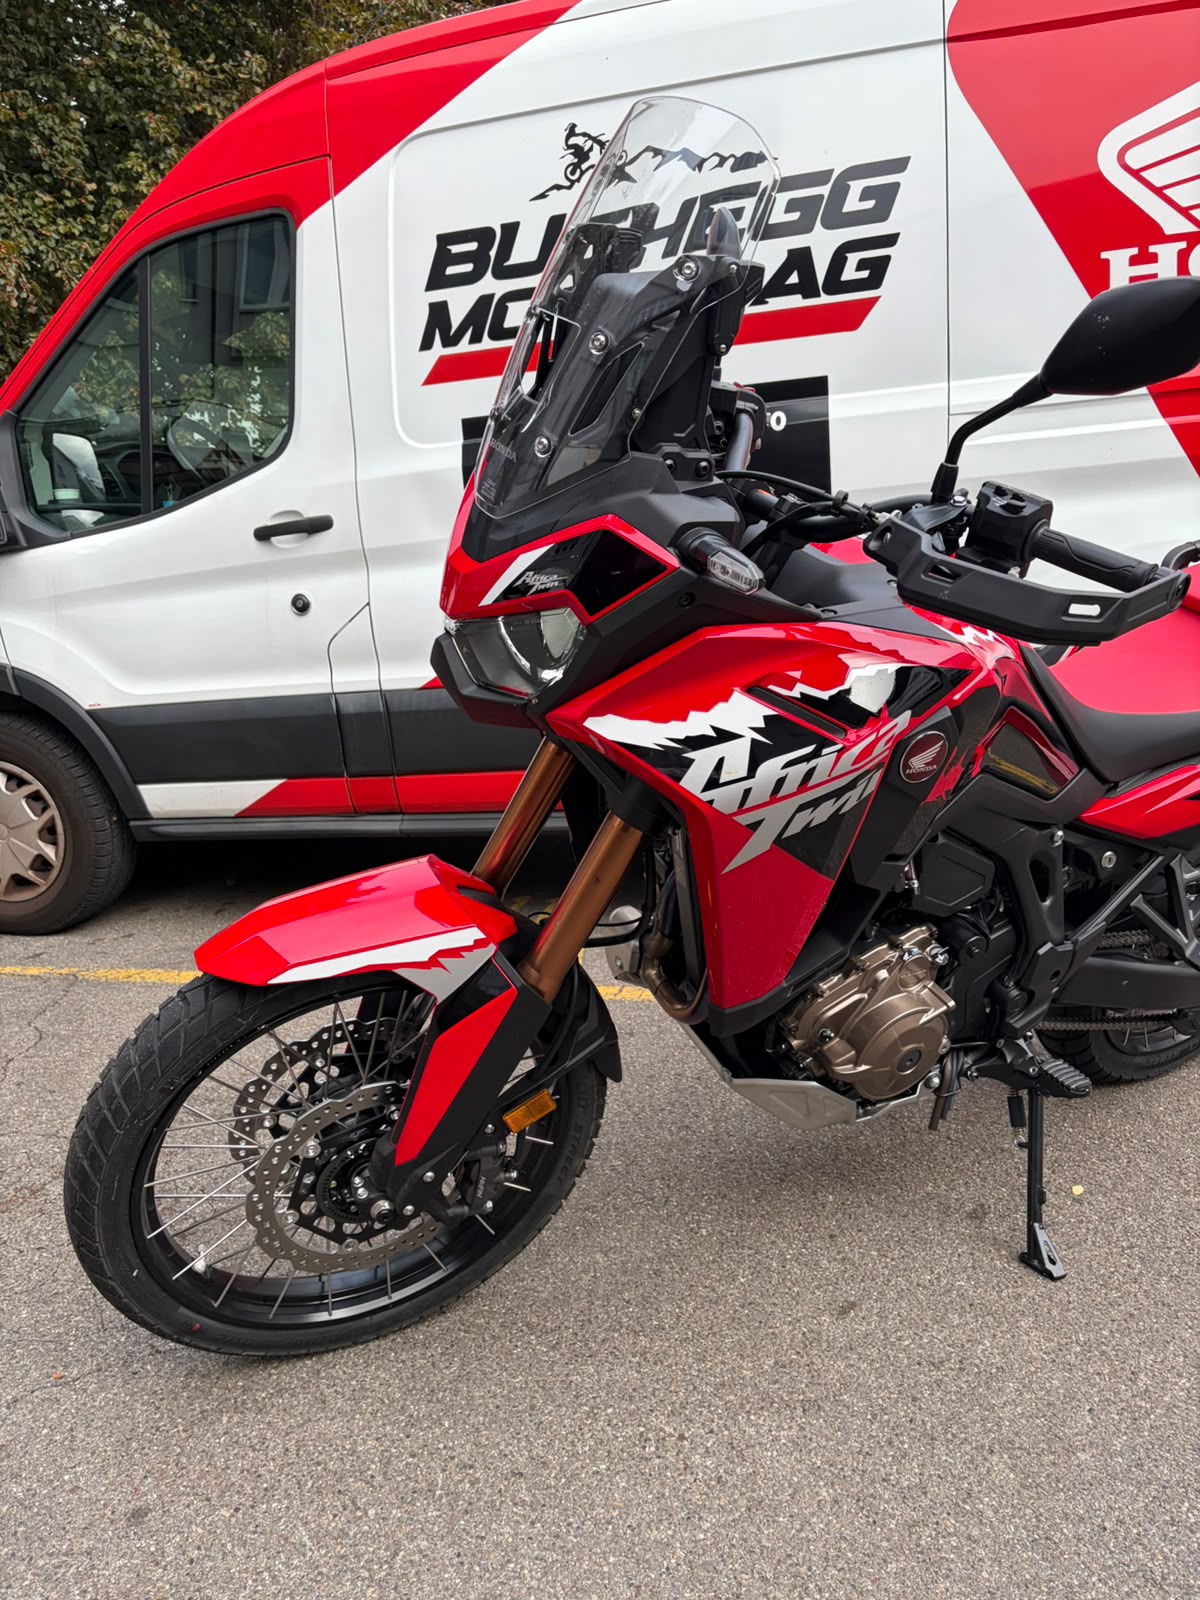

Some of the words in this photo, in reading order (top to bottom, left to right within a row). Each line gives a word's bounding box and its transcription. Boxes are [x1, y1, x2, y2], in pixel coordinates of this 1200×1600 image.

[749, 232, 901, 306] AG
[489, 438, 517, 463] HONDA
[511, 571, 569, 587] Africa
[526, 580, 563, 596] Twin
[680, 710, 912, 815] Africa
[905, 764, 938, 775] HONDA
